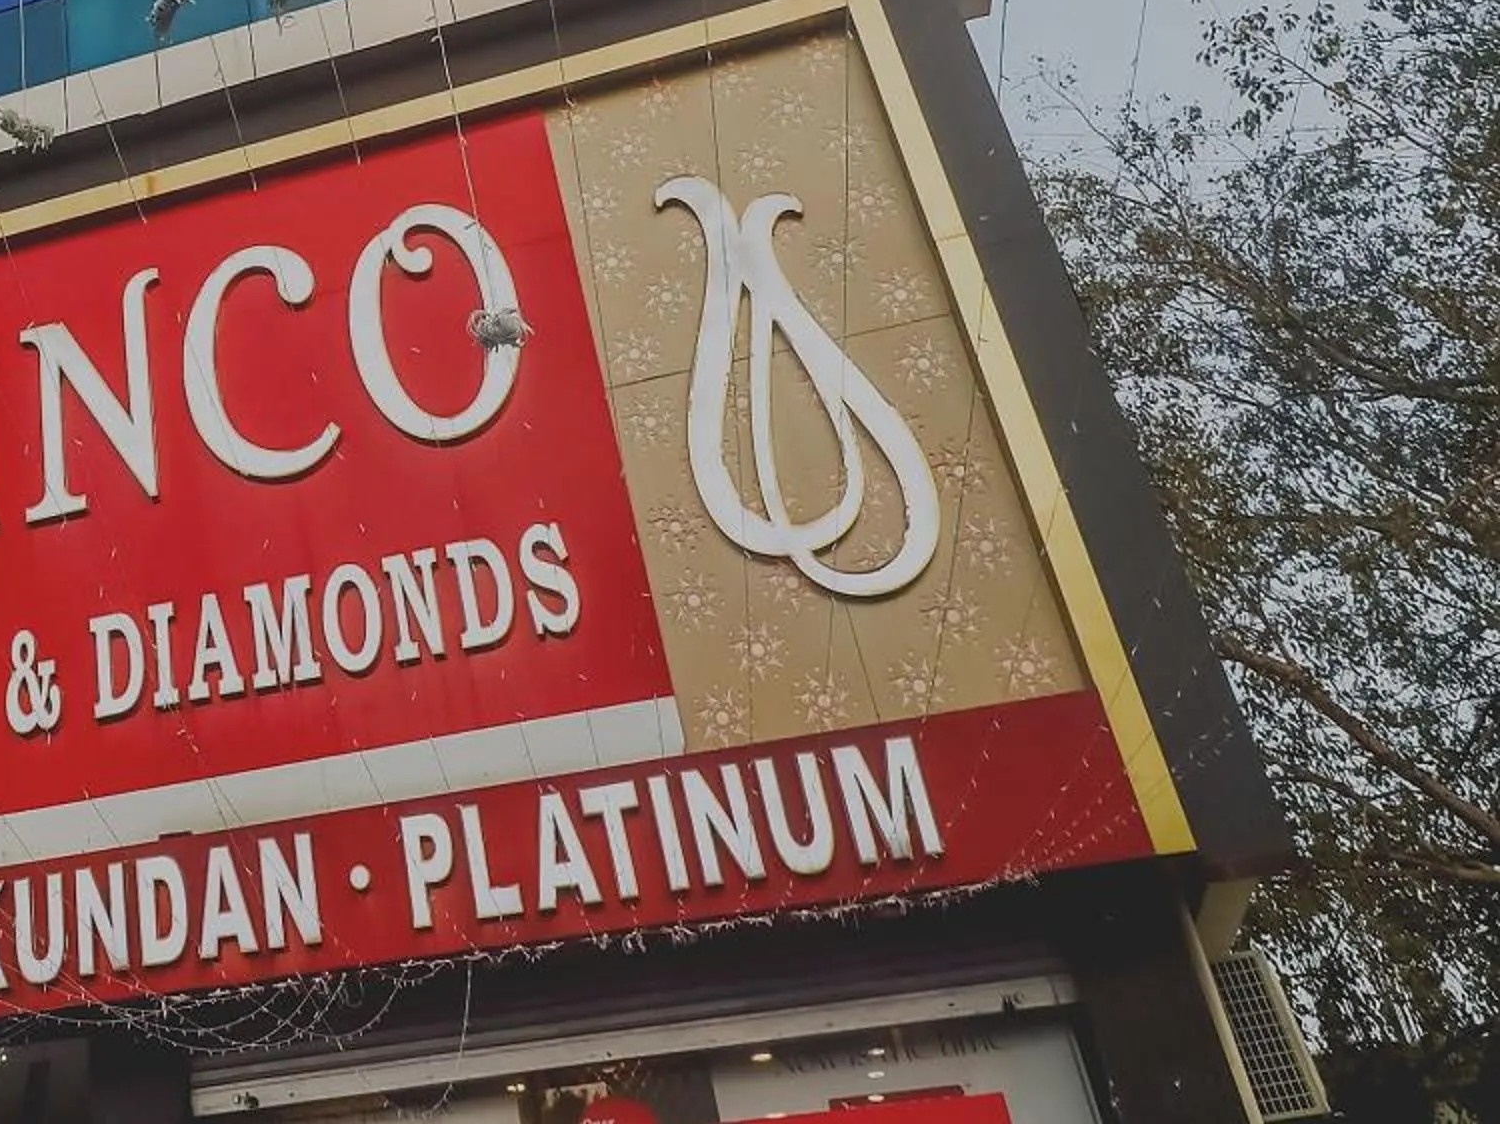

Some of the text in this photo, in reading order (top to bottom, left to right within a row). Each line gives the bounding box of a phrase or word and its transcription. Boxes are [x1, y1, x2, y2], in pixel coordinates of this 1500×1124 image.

[5, 630, 62, 736] &
[89, 523, 582, 720] DIAMONDS
[399, 736, 942, 930] PLATINUM
